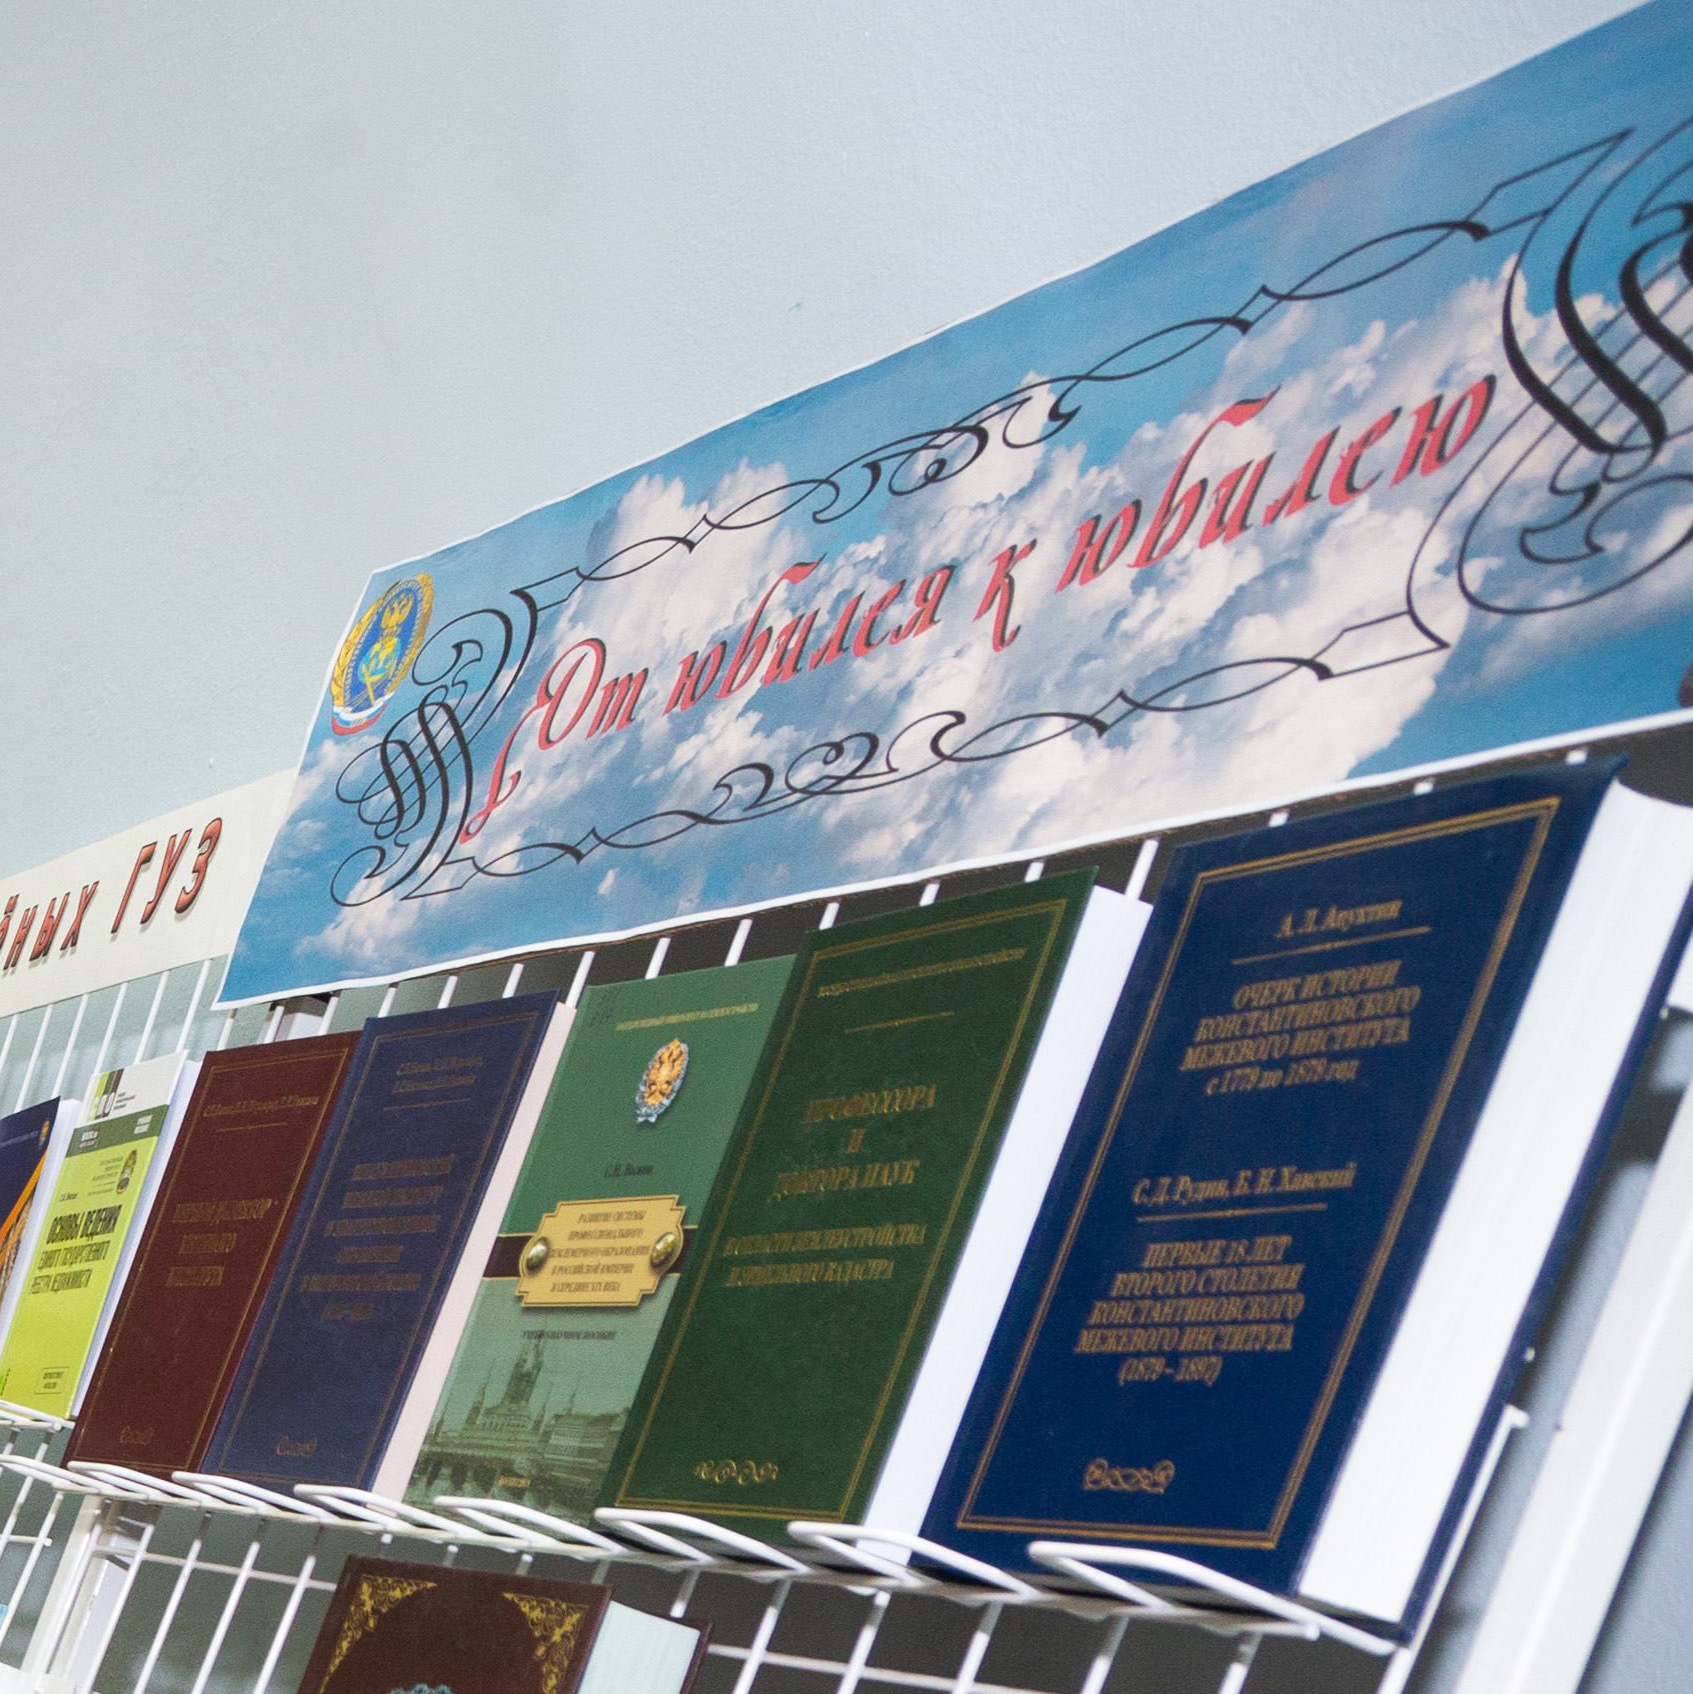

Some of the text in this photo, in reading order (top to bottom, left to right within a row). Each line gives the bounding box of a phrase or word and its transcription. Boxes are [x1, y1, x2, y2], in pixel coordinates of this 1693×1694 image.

[460, 373, 1499, 843] От юбилея к юбилею
[110, 817, 223, 934] ГУЗ
[1230, 962, 1400, 1010] ОЧЕРК ИСТОРИИ
[1192, 985, 1424, 1042] КОНСТАНТИНОВСКОГО
[1179, 1016, 1415, 1070] МЕЖЕВОГО ИНСТИТУТА
[1141, 1241, 1226, 1267] ПЕРВЫЕ
[1245, 1237, 1292, 1262] ЛЕТ
[1108, 1266, 1304, 1296] ВТОРОГО СТОЛЕТИЯ
[1087, 1295, 1307, 1324] КОНСТАНТИНОВСКОГО
[1074, 1325, 1298, 1352] МЕЖЕВОГО ИНСТИТУТА
